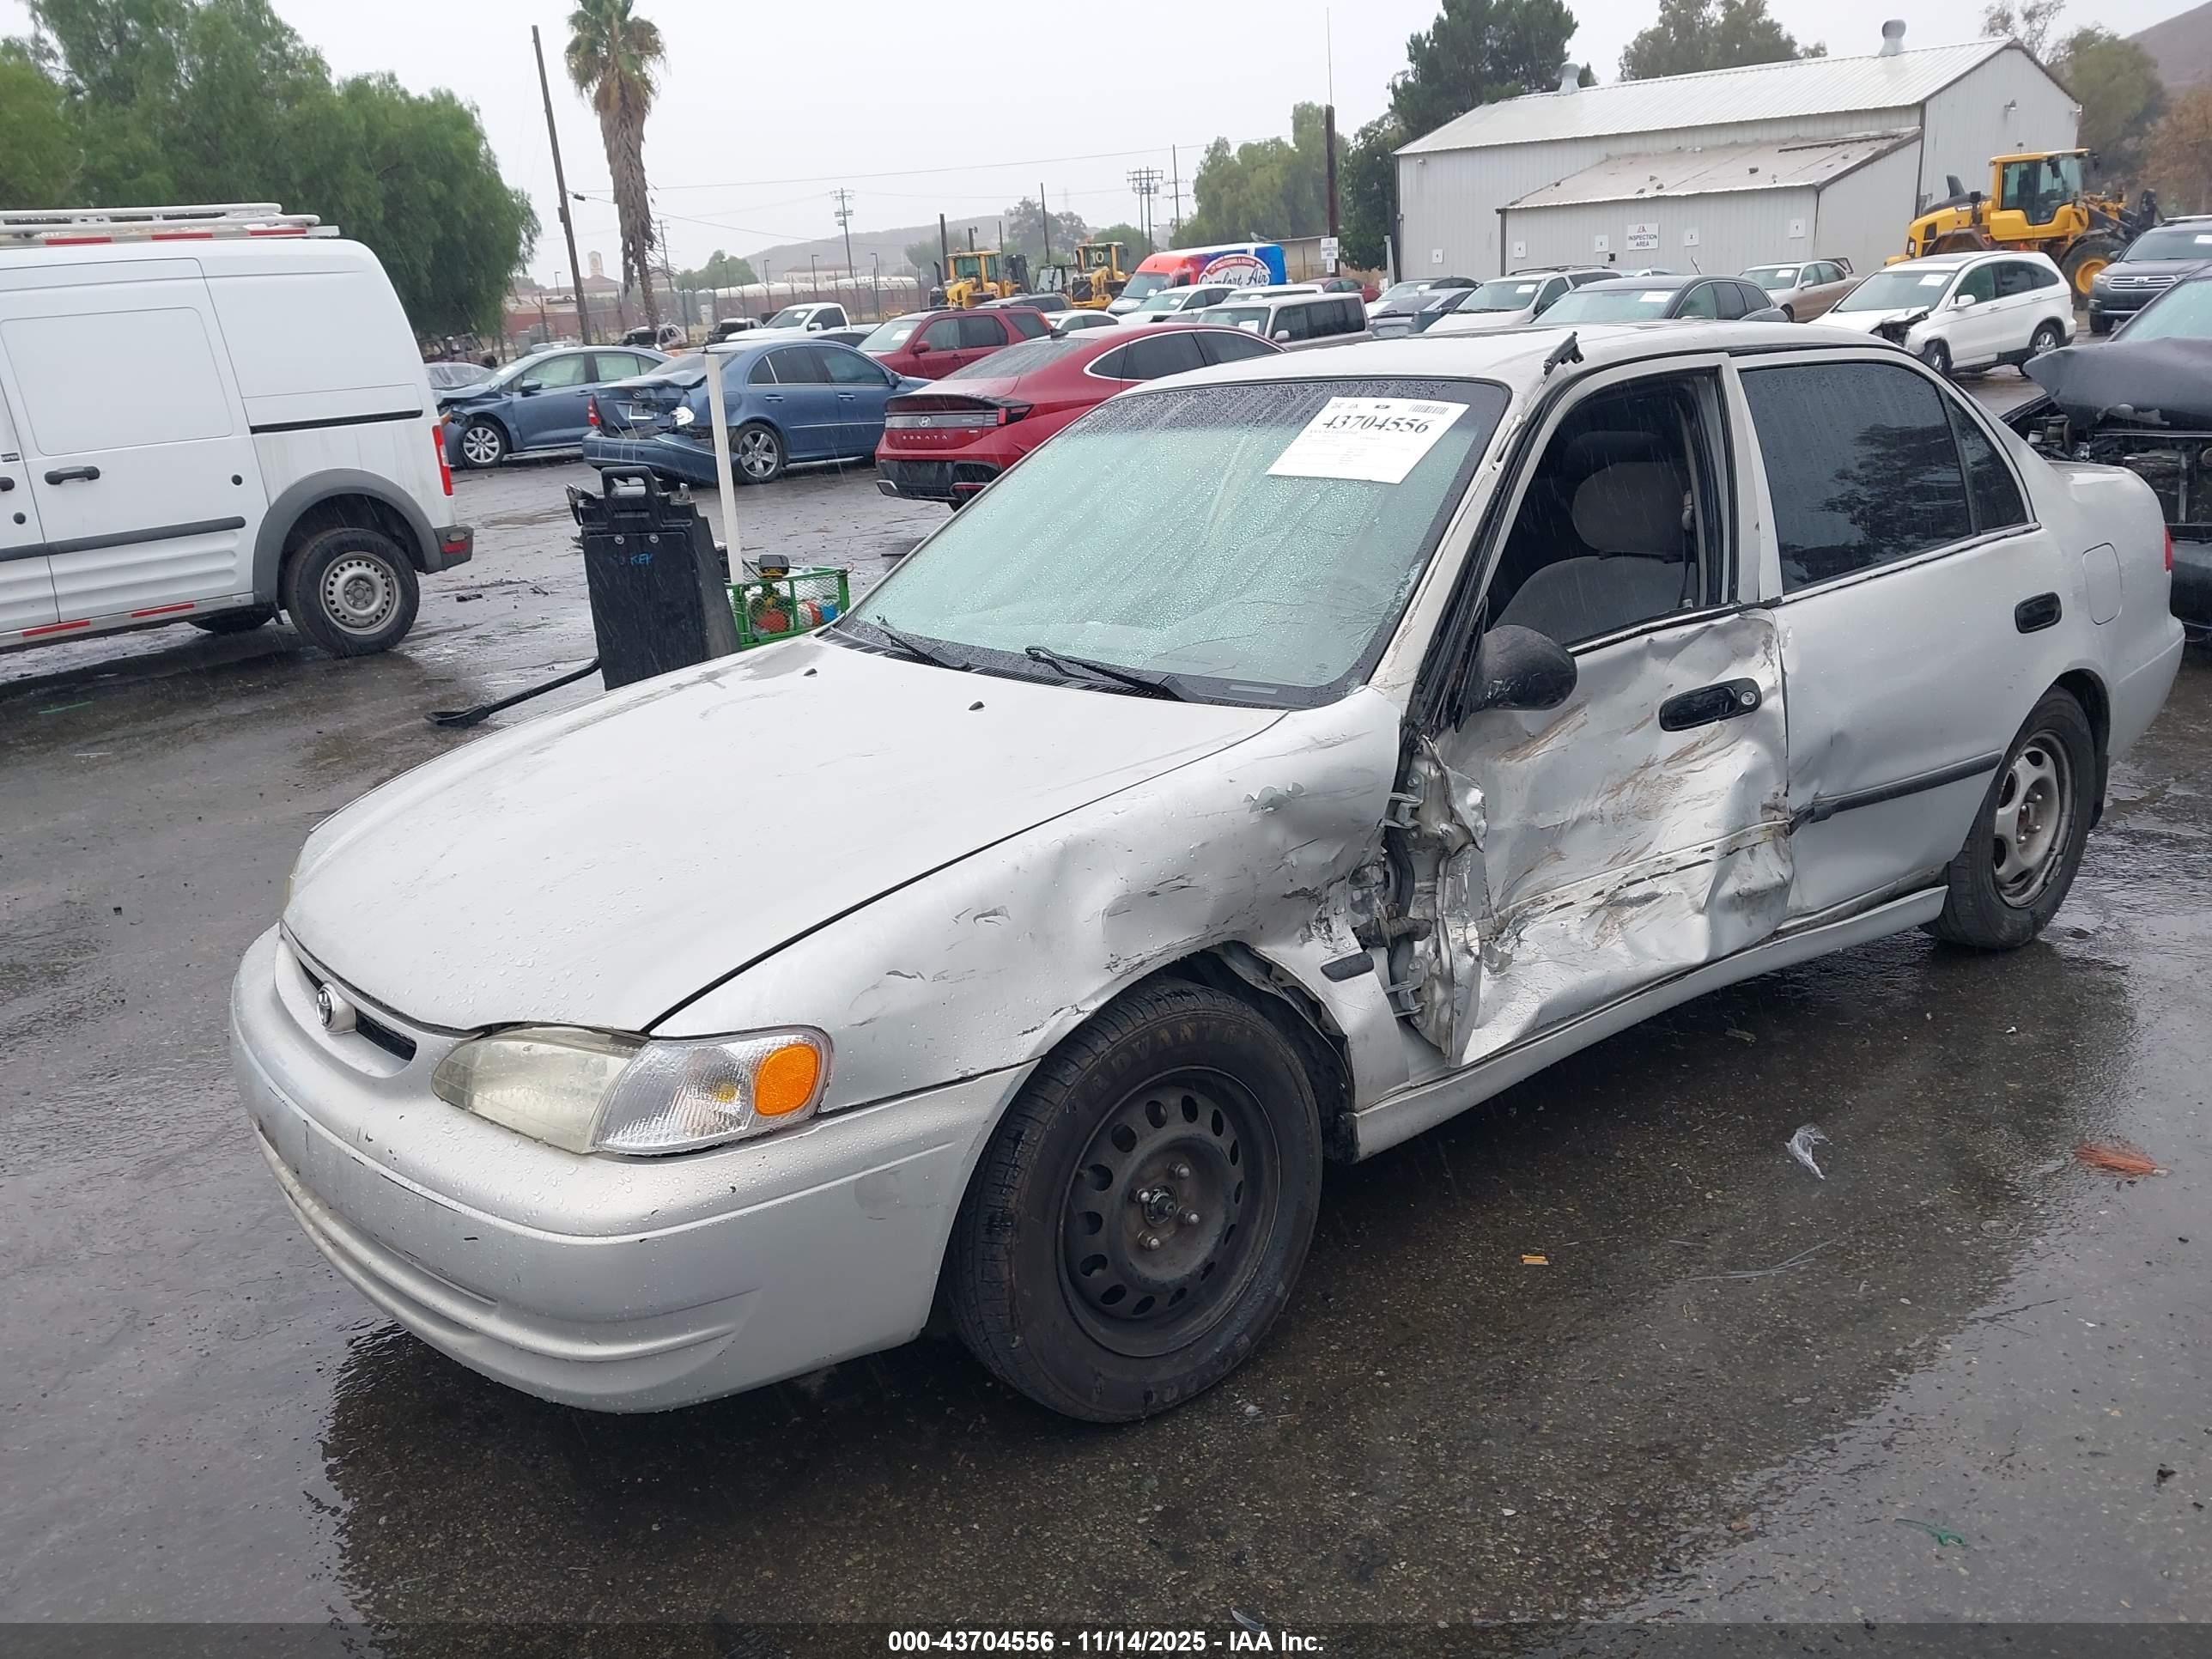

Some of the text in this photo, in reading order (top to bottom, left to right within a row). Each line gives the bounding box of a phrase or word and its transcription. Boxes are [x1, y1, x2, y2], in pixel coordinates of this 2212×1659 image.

[1200, 268, 1268, 287] Cfort Air
[1322, 415, 1435, 434] 43704556
